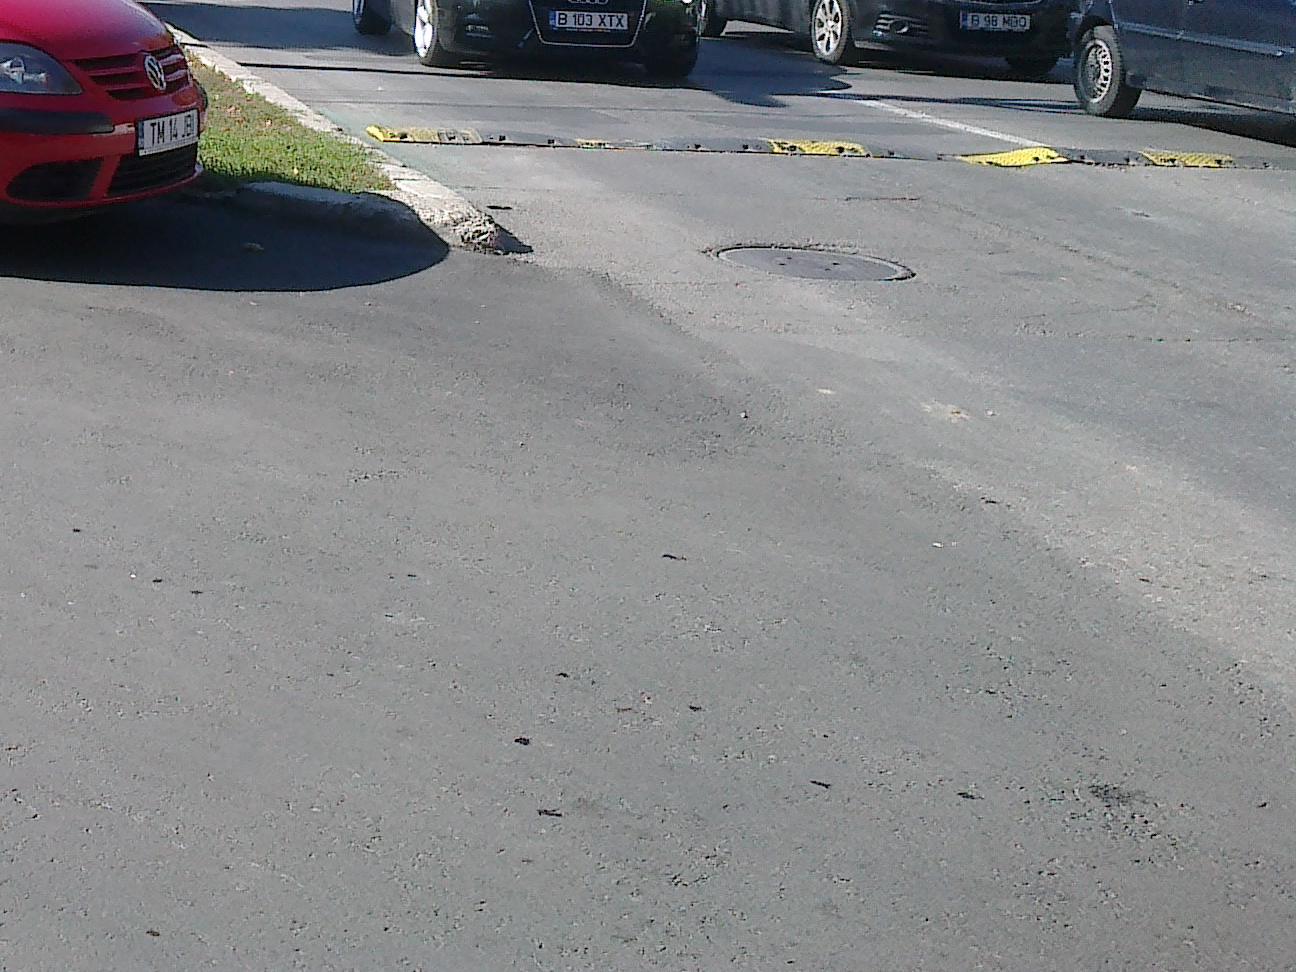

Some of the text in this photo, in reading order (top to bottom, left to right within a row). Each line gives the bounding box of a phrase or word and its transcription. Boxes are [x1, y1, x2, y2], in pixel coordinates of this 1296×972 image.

[558, 13, 624, 27] B 103 XTX
[150, 120, 165, 147] TM
